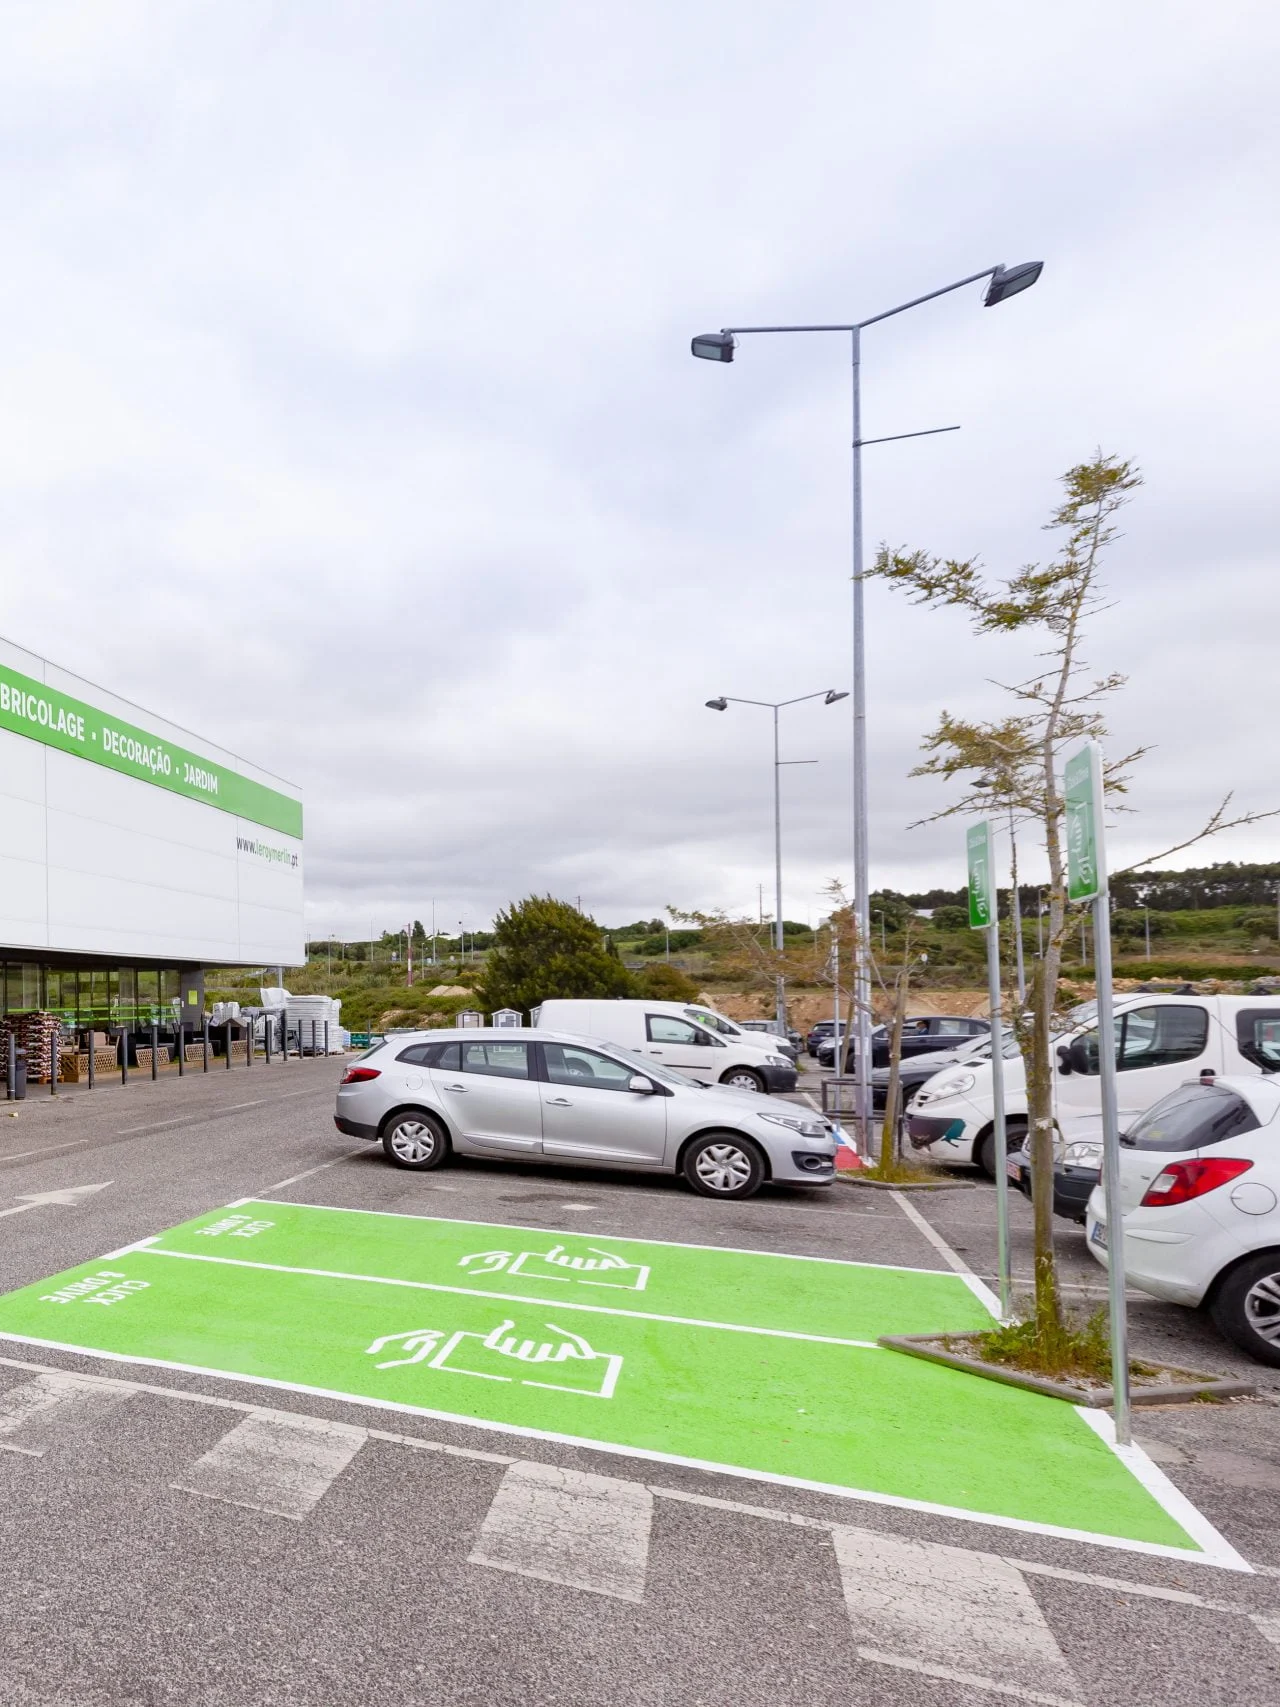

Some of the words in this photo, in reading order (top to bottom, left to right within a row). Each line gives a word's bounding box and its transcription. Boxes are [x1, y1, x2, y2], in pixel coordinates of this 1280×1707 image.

[0, 682, 86, 742] BRICOLAGE
[102, 727, 172, 776] DECORAÇÃO
[183, 762, 219, 795] JARDIM
[236, 836, 298, 869] www.leroymerlin.pt
[227, 1220, 277, 1238] CLICK
[38, 1277, 112, 1304] DRIVE
[83, 1280, 152, 1306] CLICK
